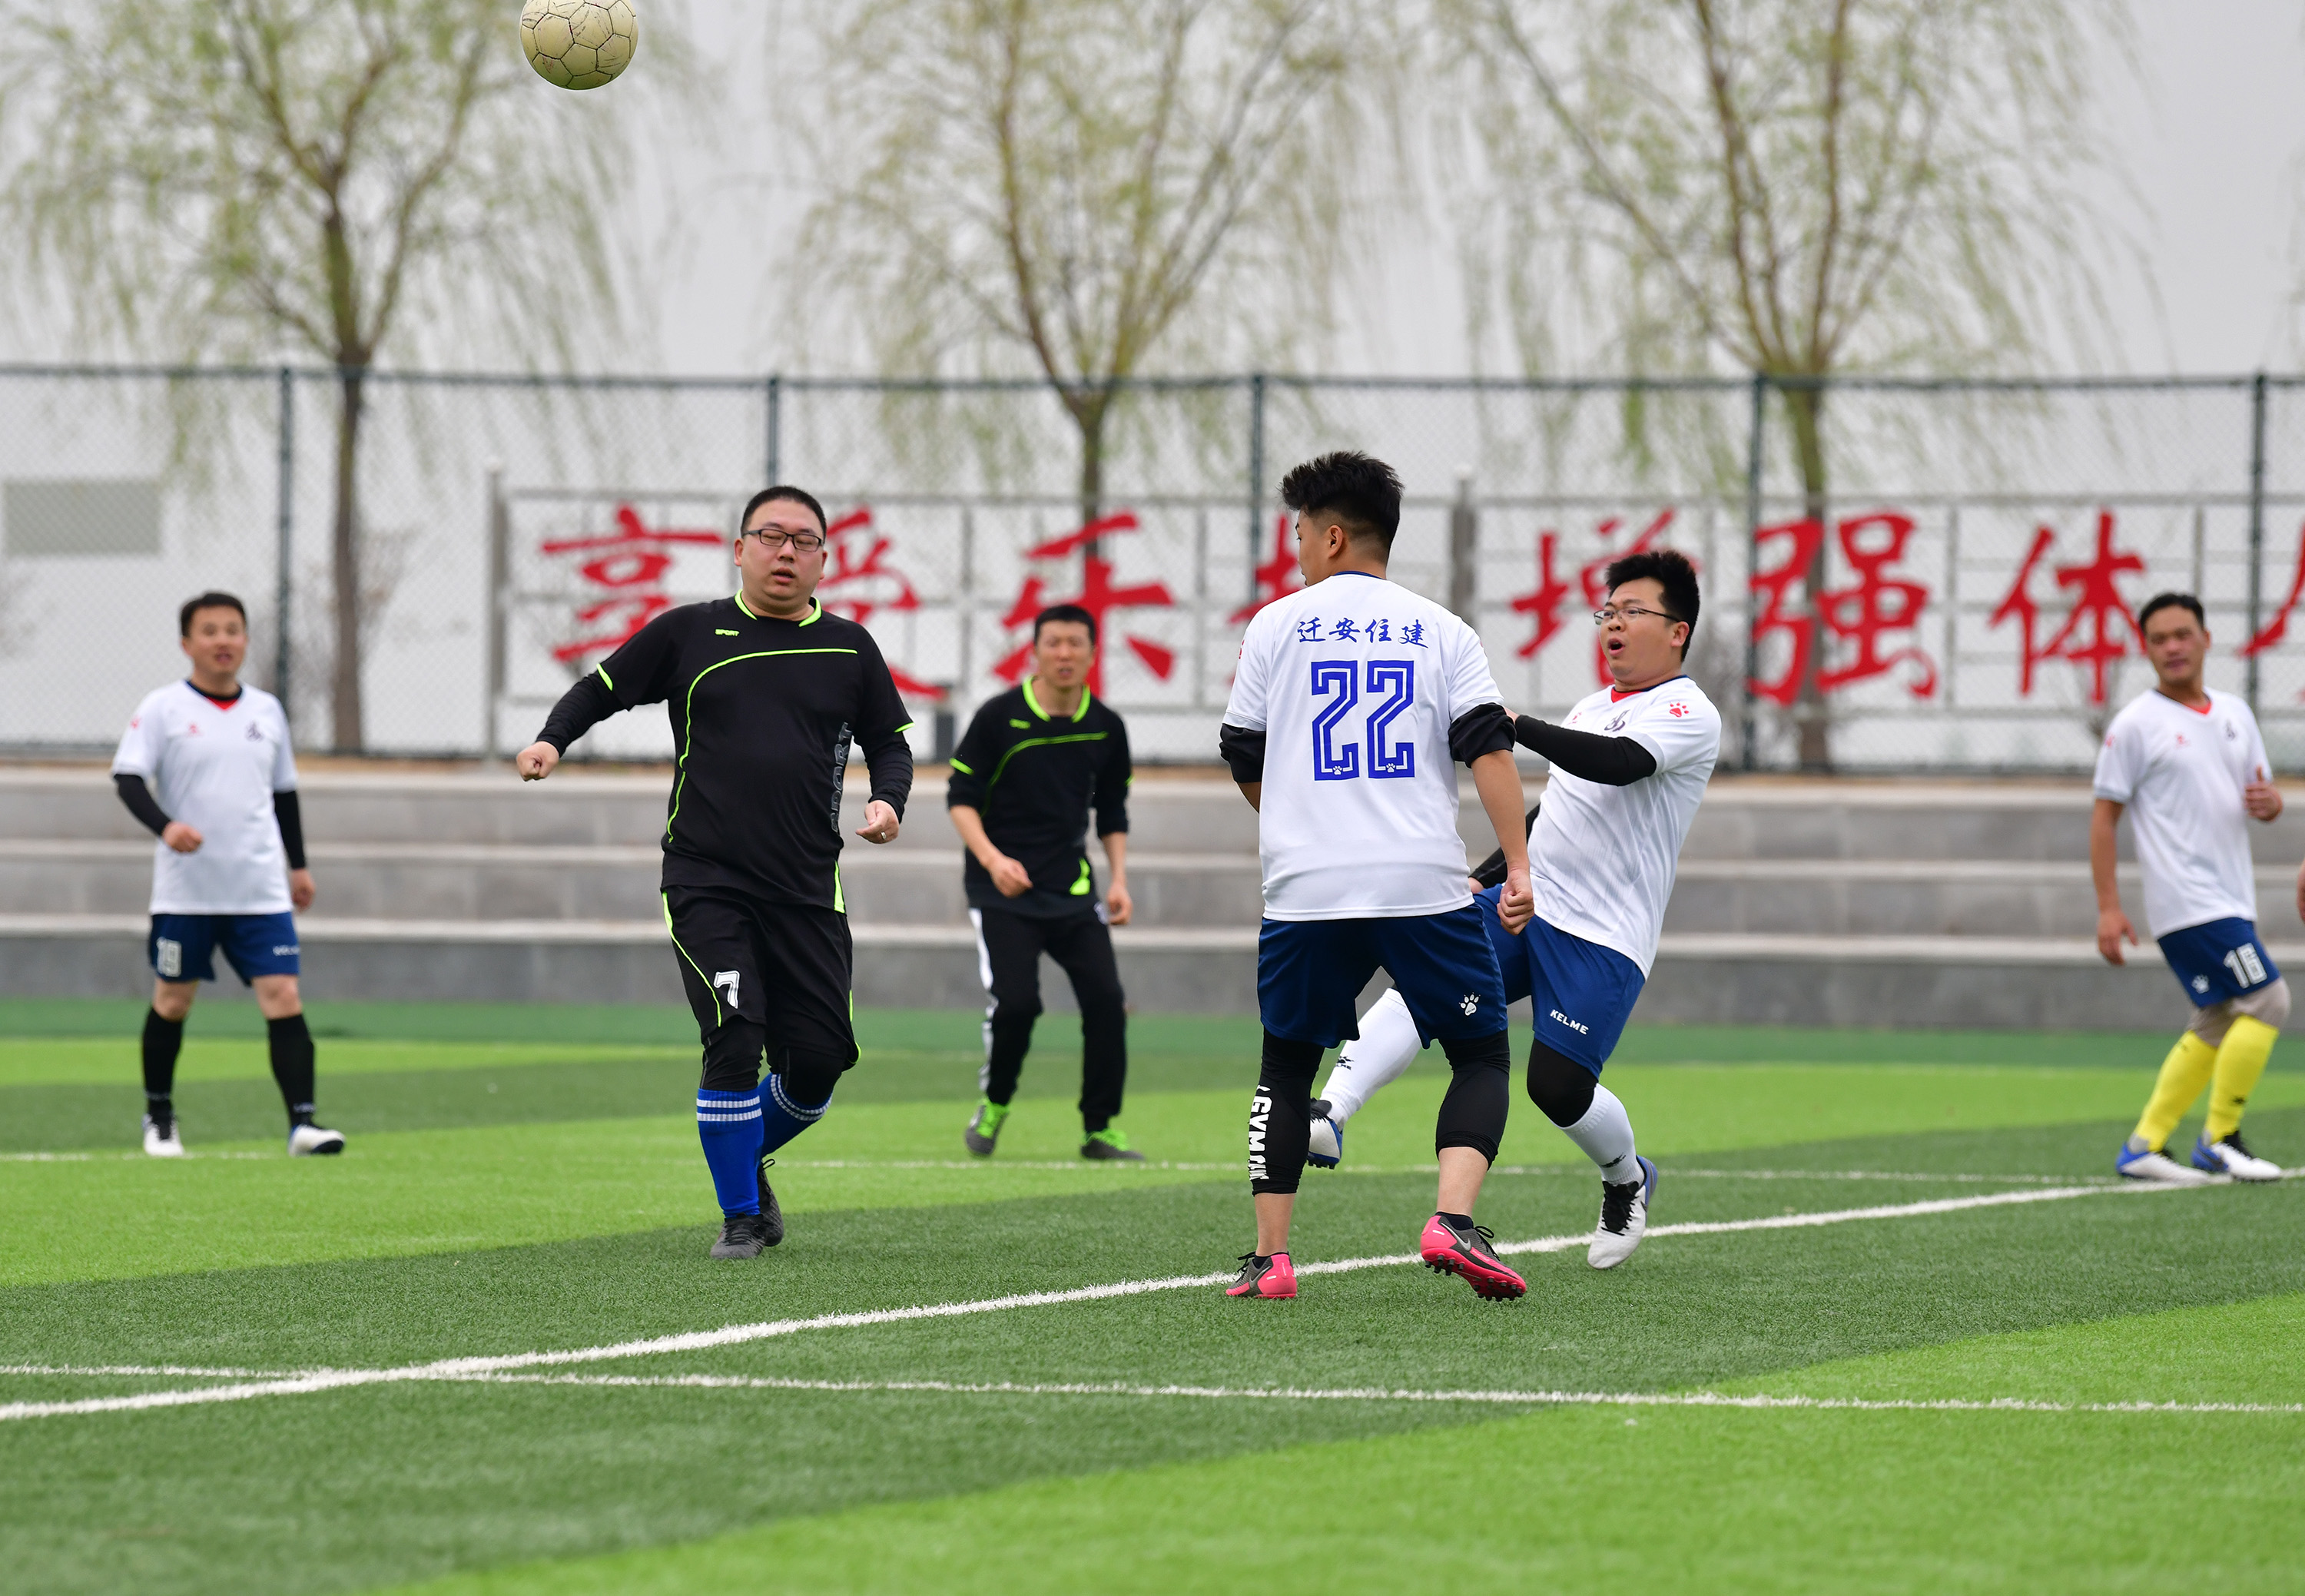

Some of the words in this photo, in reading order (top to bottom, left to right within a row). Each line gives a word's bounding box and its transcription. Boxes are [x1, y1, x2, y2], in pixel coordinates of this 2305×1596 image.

[1296, 617, 1429, 649] 迁安住建
[1311, 659, 1416, 781] 22
[2223, 942, 2268, 990] 16
[714, 970, 741, 1010] 7
[1550, 1009, 1590, 1035] KELME
